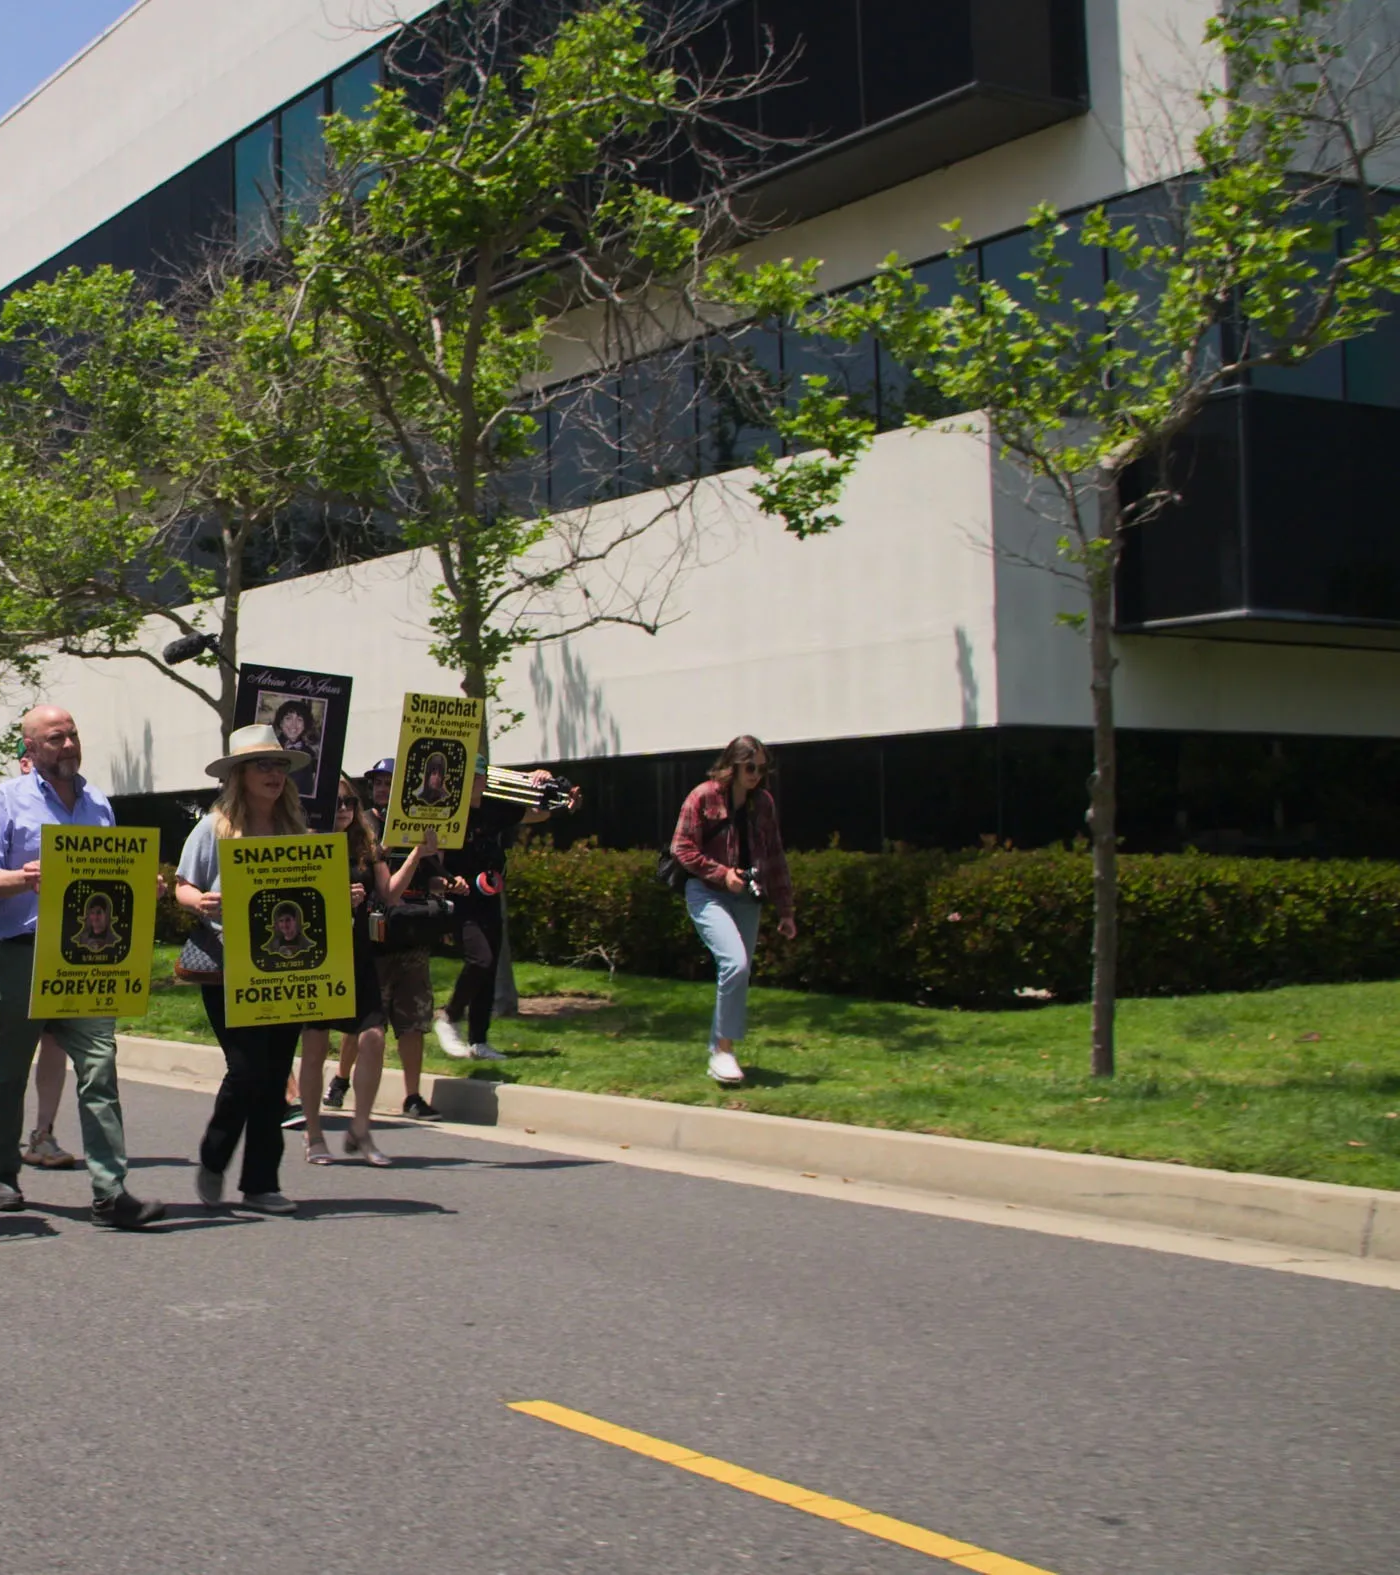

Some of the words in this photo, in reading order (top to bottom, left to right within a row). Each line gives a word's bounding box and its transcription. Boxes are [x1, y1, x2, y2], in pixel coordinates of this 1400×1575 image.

[411, 693, 477, 718] Snapchat
[414, 716, 426, 724] An
[429, 718, 480, 729] Accomplice
[411, 725, 422, 733] To
[424, 726, 438, 736] My
[440, 728, 471, 738] Murder
[445, 822, 460, 833] 19
[54, 835, 148, 853] SNAPCHAT
[89, 855, 135, 866] accomplice
[233, 844, 334, 864] SNAPCHAT
[71, 867, 79, 875] to
[82, 869, 95, 877] my
[98, 867, 129, 875] murder
[272, 864, 322, 874] accomplice
[254, 877, 263, 885] to
[283, 874, 316, 883] murder
[56, 968, 89, 978] Sammy
[91, 968, 130, 978] Chapman
[250, 976, 284, 986] Sammy
[287, 973, 331, 983] Chapman
[41, 979, 117, 996] FOREVER
[125, 978, 142, 994] 16
[235, 983, 318, 1004] FOREVER
[326, 980, 346, 997] 16
